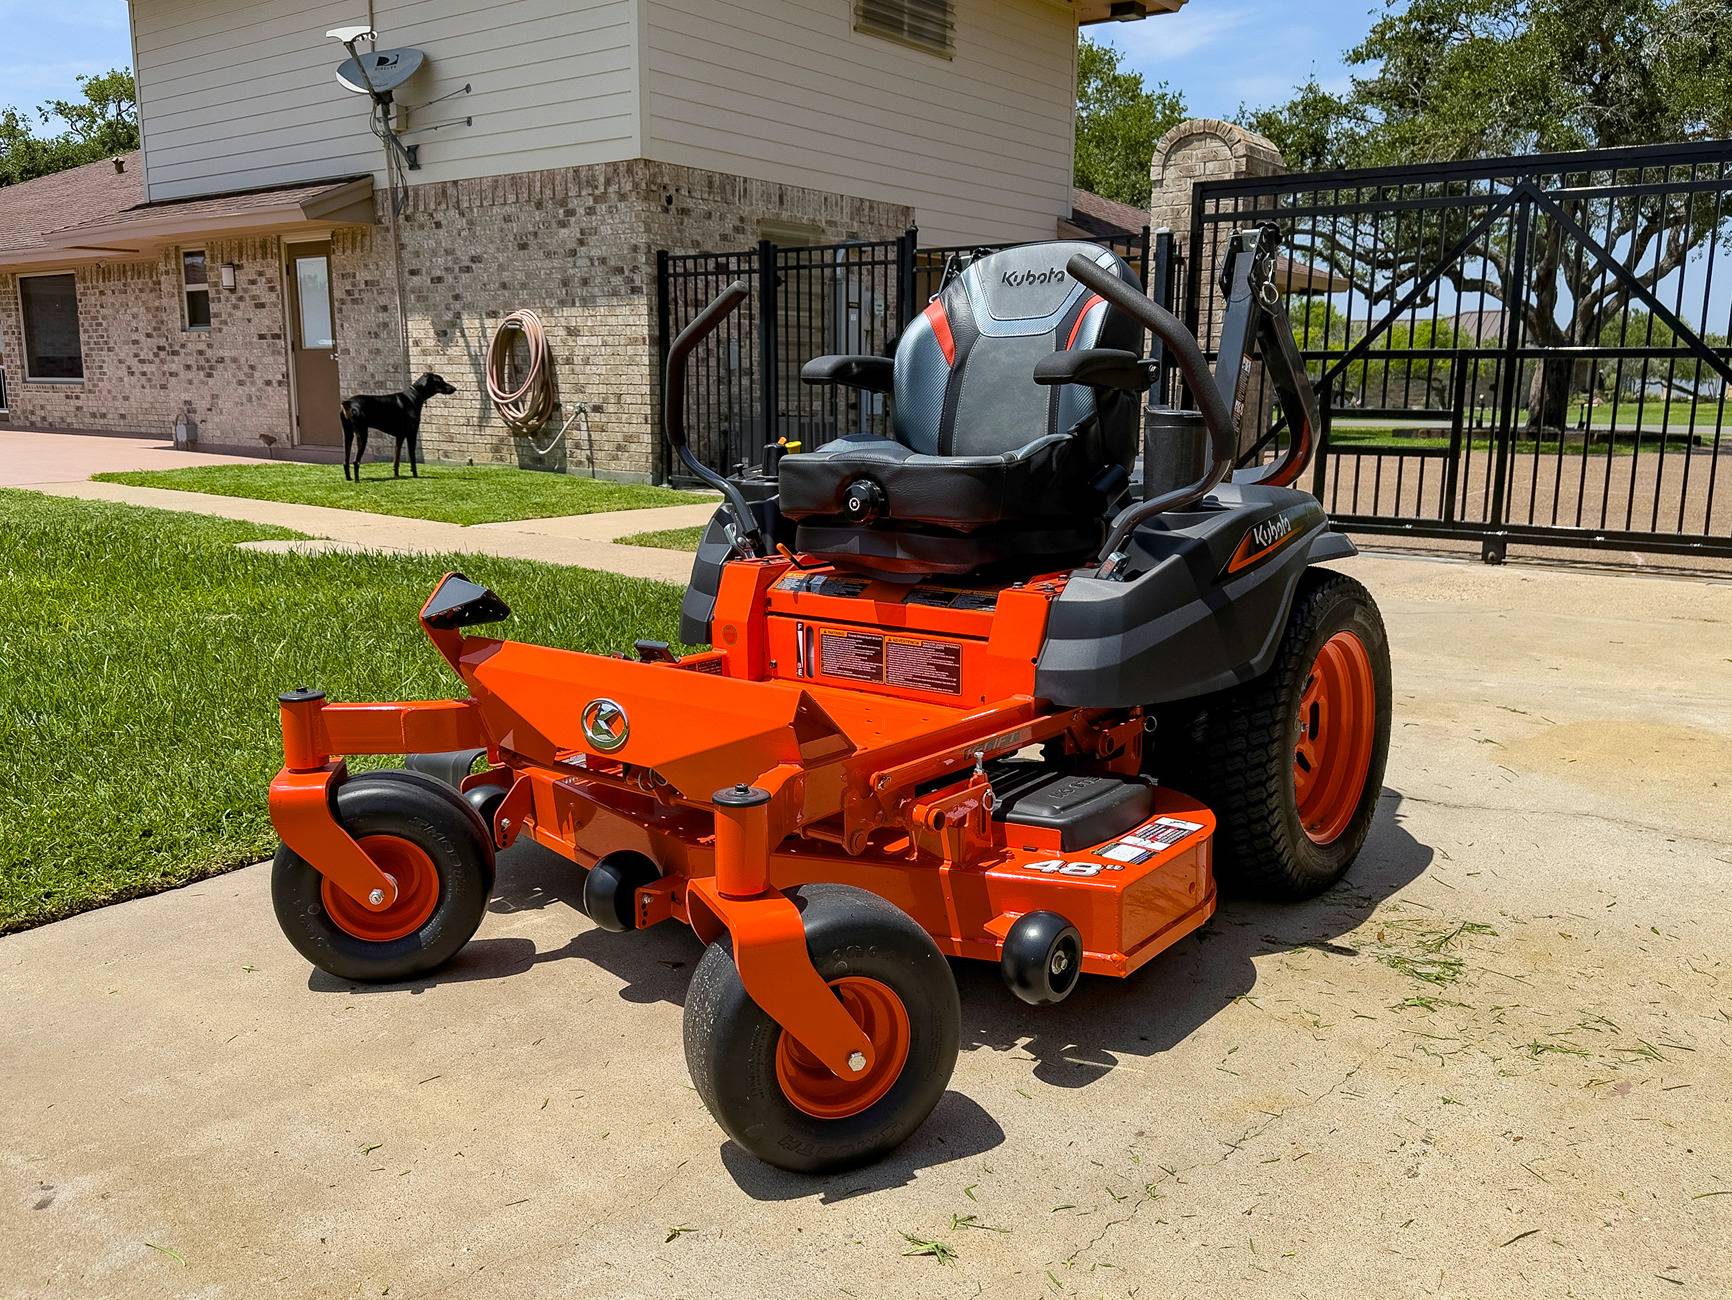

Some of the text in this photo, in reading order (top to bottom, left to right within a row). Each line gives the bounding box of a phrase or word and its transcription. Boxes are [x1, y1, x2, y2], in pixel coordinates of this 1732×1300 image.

[1001, 267, 1066, 287] Kubota
[1253, 514, 1292, 547] Kubota
[797, 623, 803, 631] F
[797, 668, 803, 677] E
